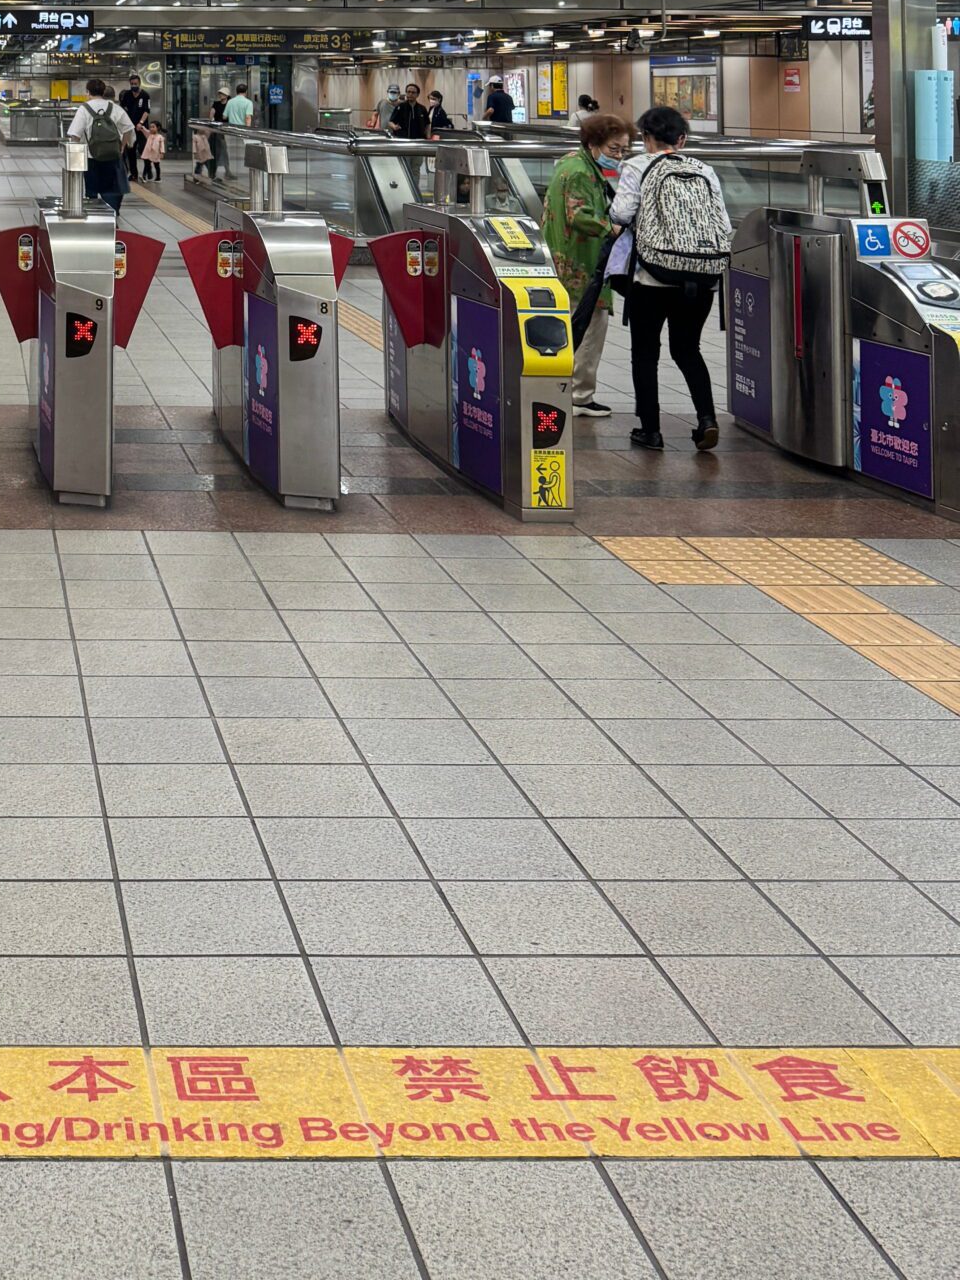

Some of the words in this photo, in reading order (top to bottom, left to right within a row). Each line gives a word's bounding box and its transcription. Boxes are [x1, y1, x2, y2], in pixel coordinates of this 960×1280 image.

[39, 12, 59, 22] 月台
[842, 17, 862, 28] 月台
[225, 34, 236, 48] 2
[331, 34, 341, 48] 3
[95, 298, 104, 310] 9
[320, 302, 329, 314] 8
[559, 383, 567, 393] 7
[871, 445, 895, 460] WELCOME
[903, 455, 918, 467] TAIPEI
[392, 1055, 866, 1103] 禁止飲食
[298, 1116, 500, 1148] Beyond
[510, 1116, 596, 1141] the
[598, 1116, 770, 1142] Yellow
[784, 1116, 902, 1141] Line
